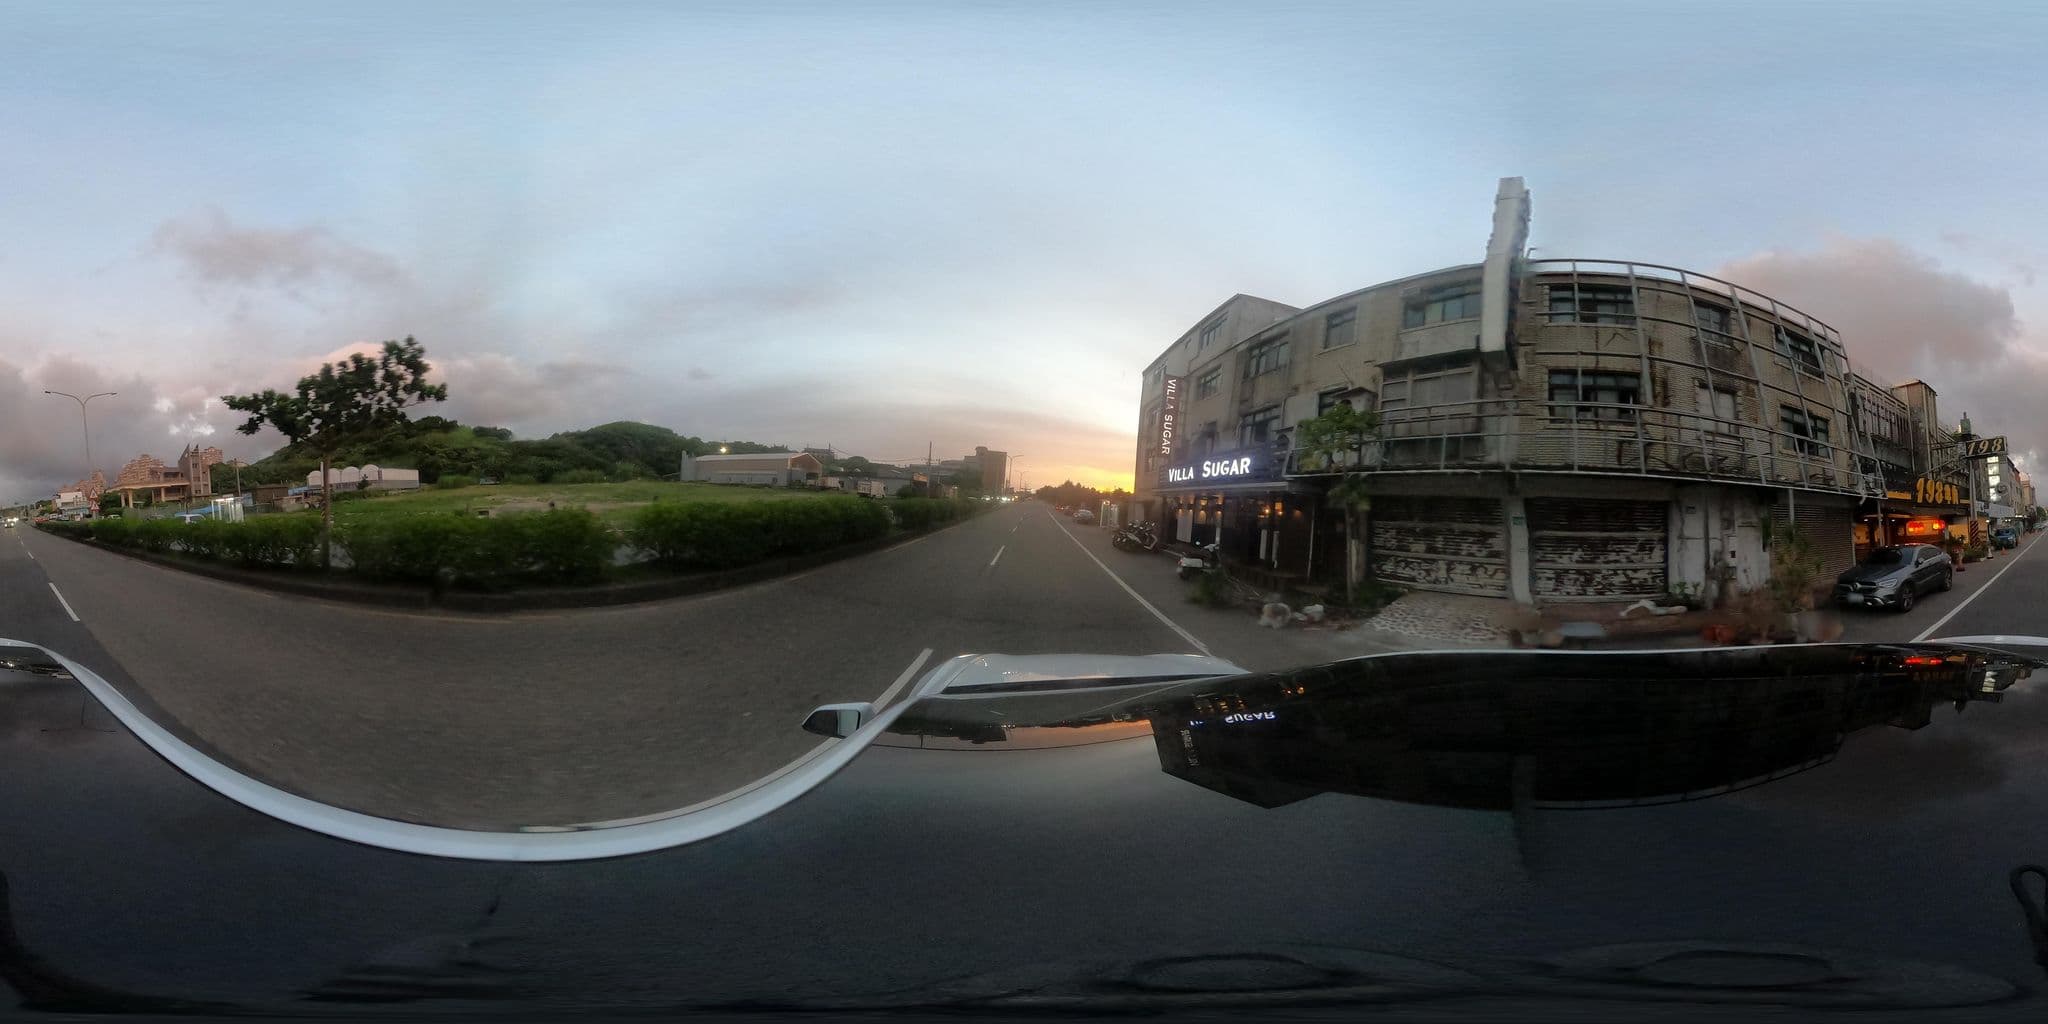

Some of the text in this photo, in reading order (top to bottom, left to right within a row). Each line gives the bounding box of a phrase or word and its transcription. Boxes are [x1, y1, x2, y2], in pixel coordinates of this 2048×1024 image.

[1161, 379, 1177, 455] VILLA SUGAR
[1967, 438, 2003, 456] 198
[1168, 457, 1251, 483] VILLA SUGAR
